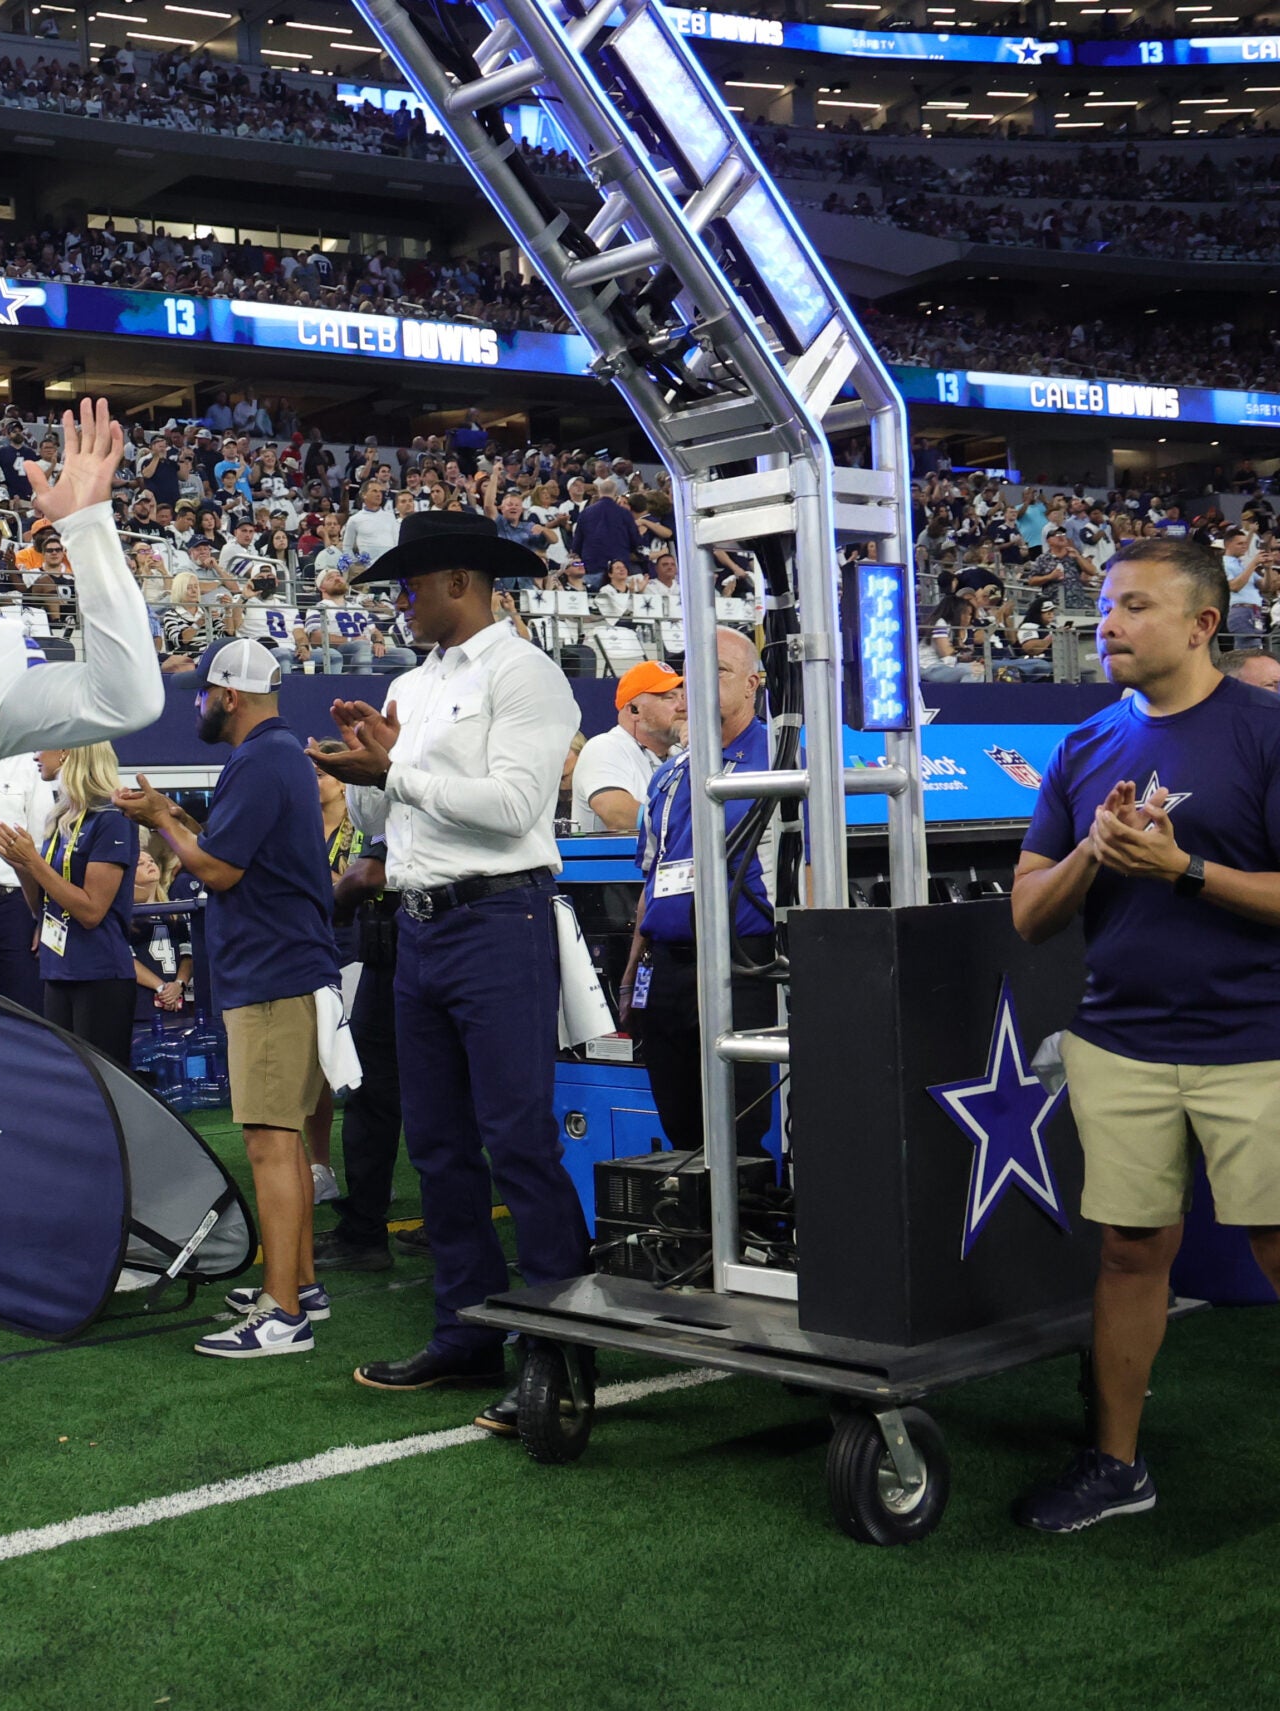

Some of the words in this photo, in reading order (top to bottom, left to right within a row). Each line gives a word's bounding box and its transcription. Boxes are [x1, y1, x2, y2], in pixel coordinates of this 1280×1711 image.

[710, 13, 784, 46] DOWNS
[851, 38, 896, 50] SAFETY
[1138, 41, 1164, 64] 13
[164, 298, 196, 336] 13
[298, 314, 397, 352] CALEB
[402, 319, 499, 365] DOWNS
[936, 372, 959, 403] 13
[1030, 381, 1104, 411] CALEB
[1108, 384, 1181, 418] DOWNS
[148, 924, 177, 974] 4
